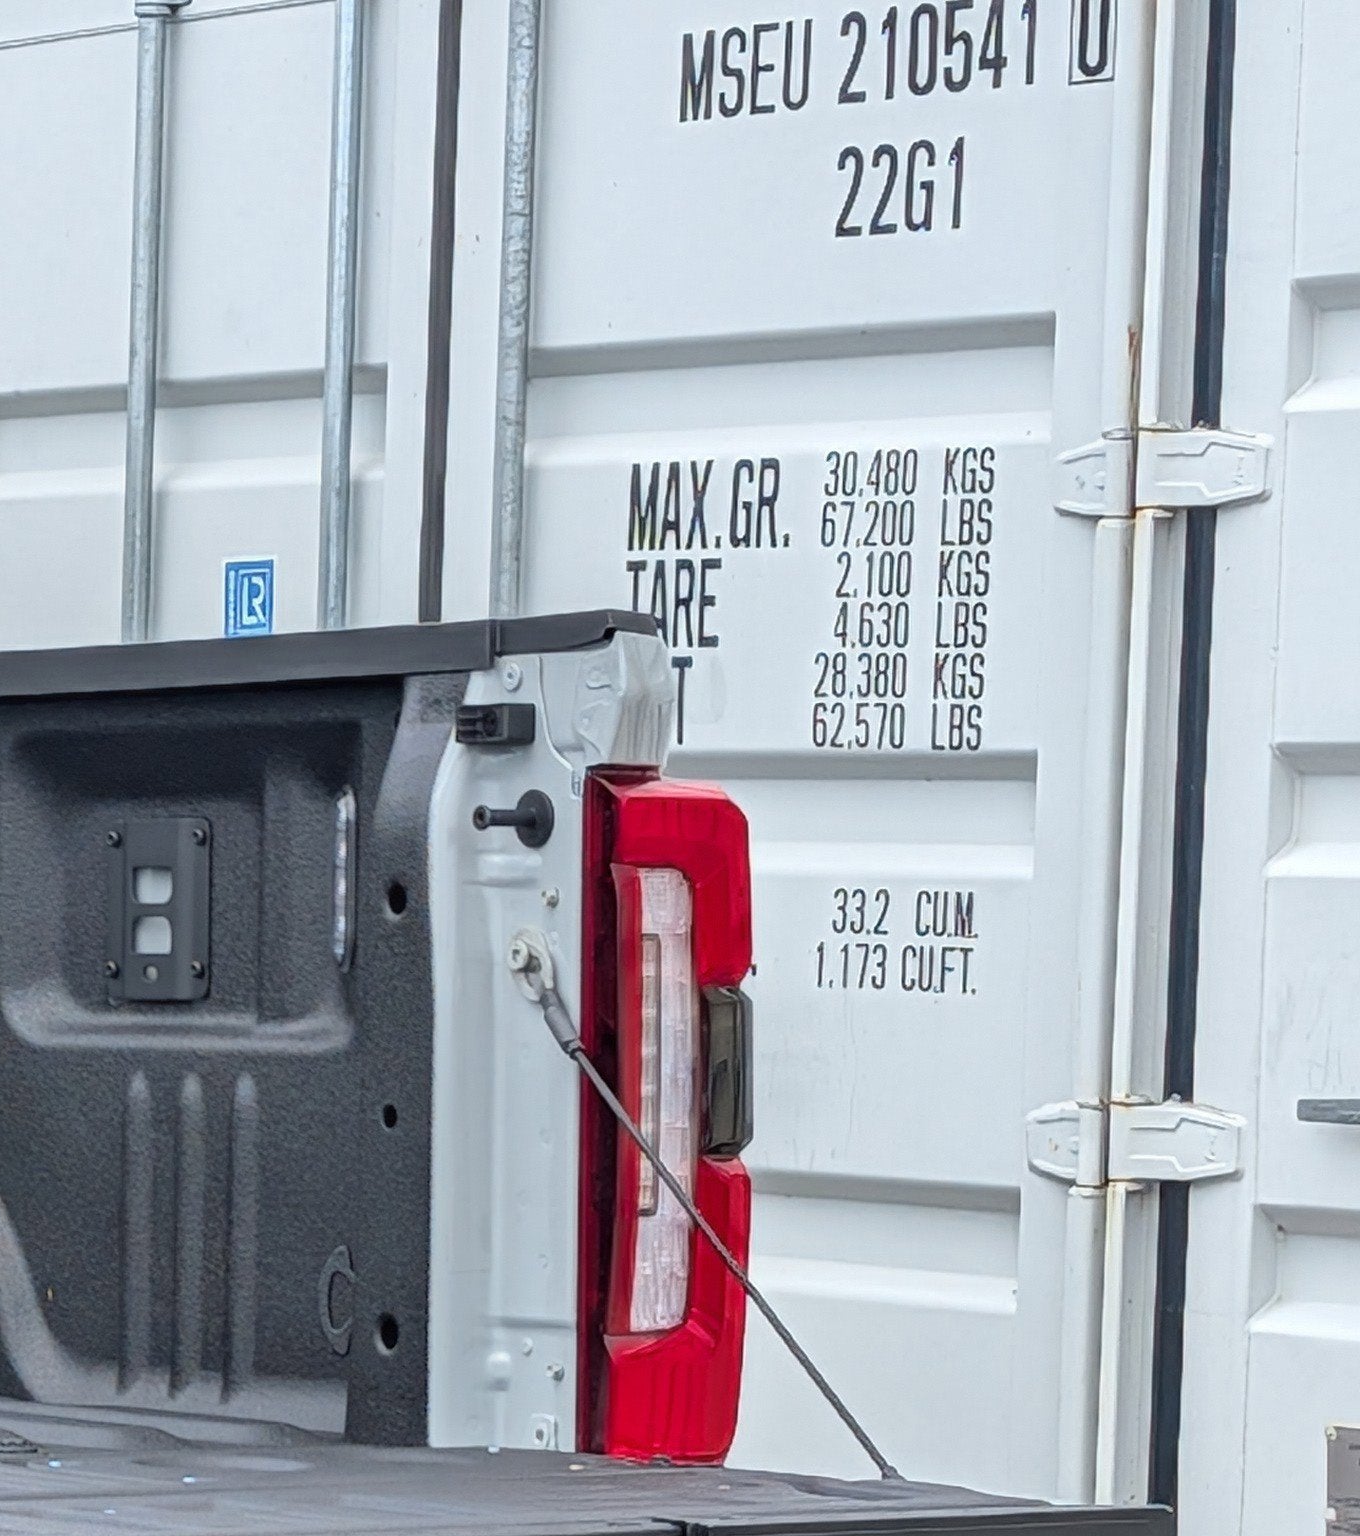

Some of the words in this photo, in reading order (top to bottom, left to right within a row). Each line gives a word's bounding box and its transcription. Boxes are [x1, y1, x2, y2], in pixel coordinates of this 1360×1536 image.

[679, 18, 813, 123] MSEU
[838, 0, 1037, 104] 210541
[835, 136, 965, 237] 22G1
[943, 447, 995, 495] KGS
[940, 498, 992, 546] LBS
[938, 550, 990, 598] KGS
[626, 557, 722, 648] TARE
[935, 601, 988, 649] LBS
[933, 652, 985, 700] KGS
[931, 703, 983, 751] LBS
[832, 888, 890, 935] 33.2
